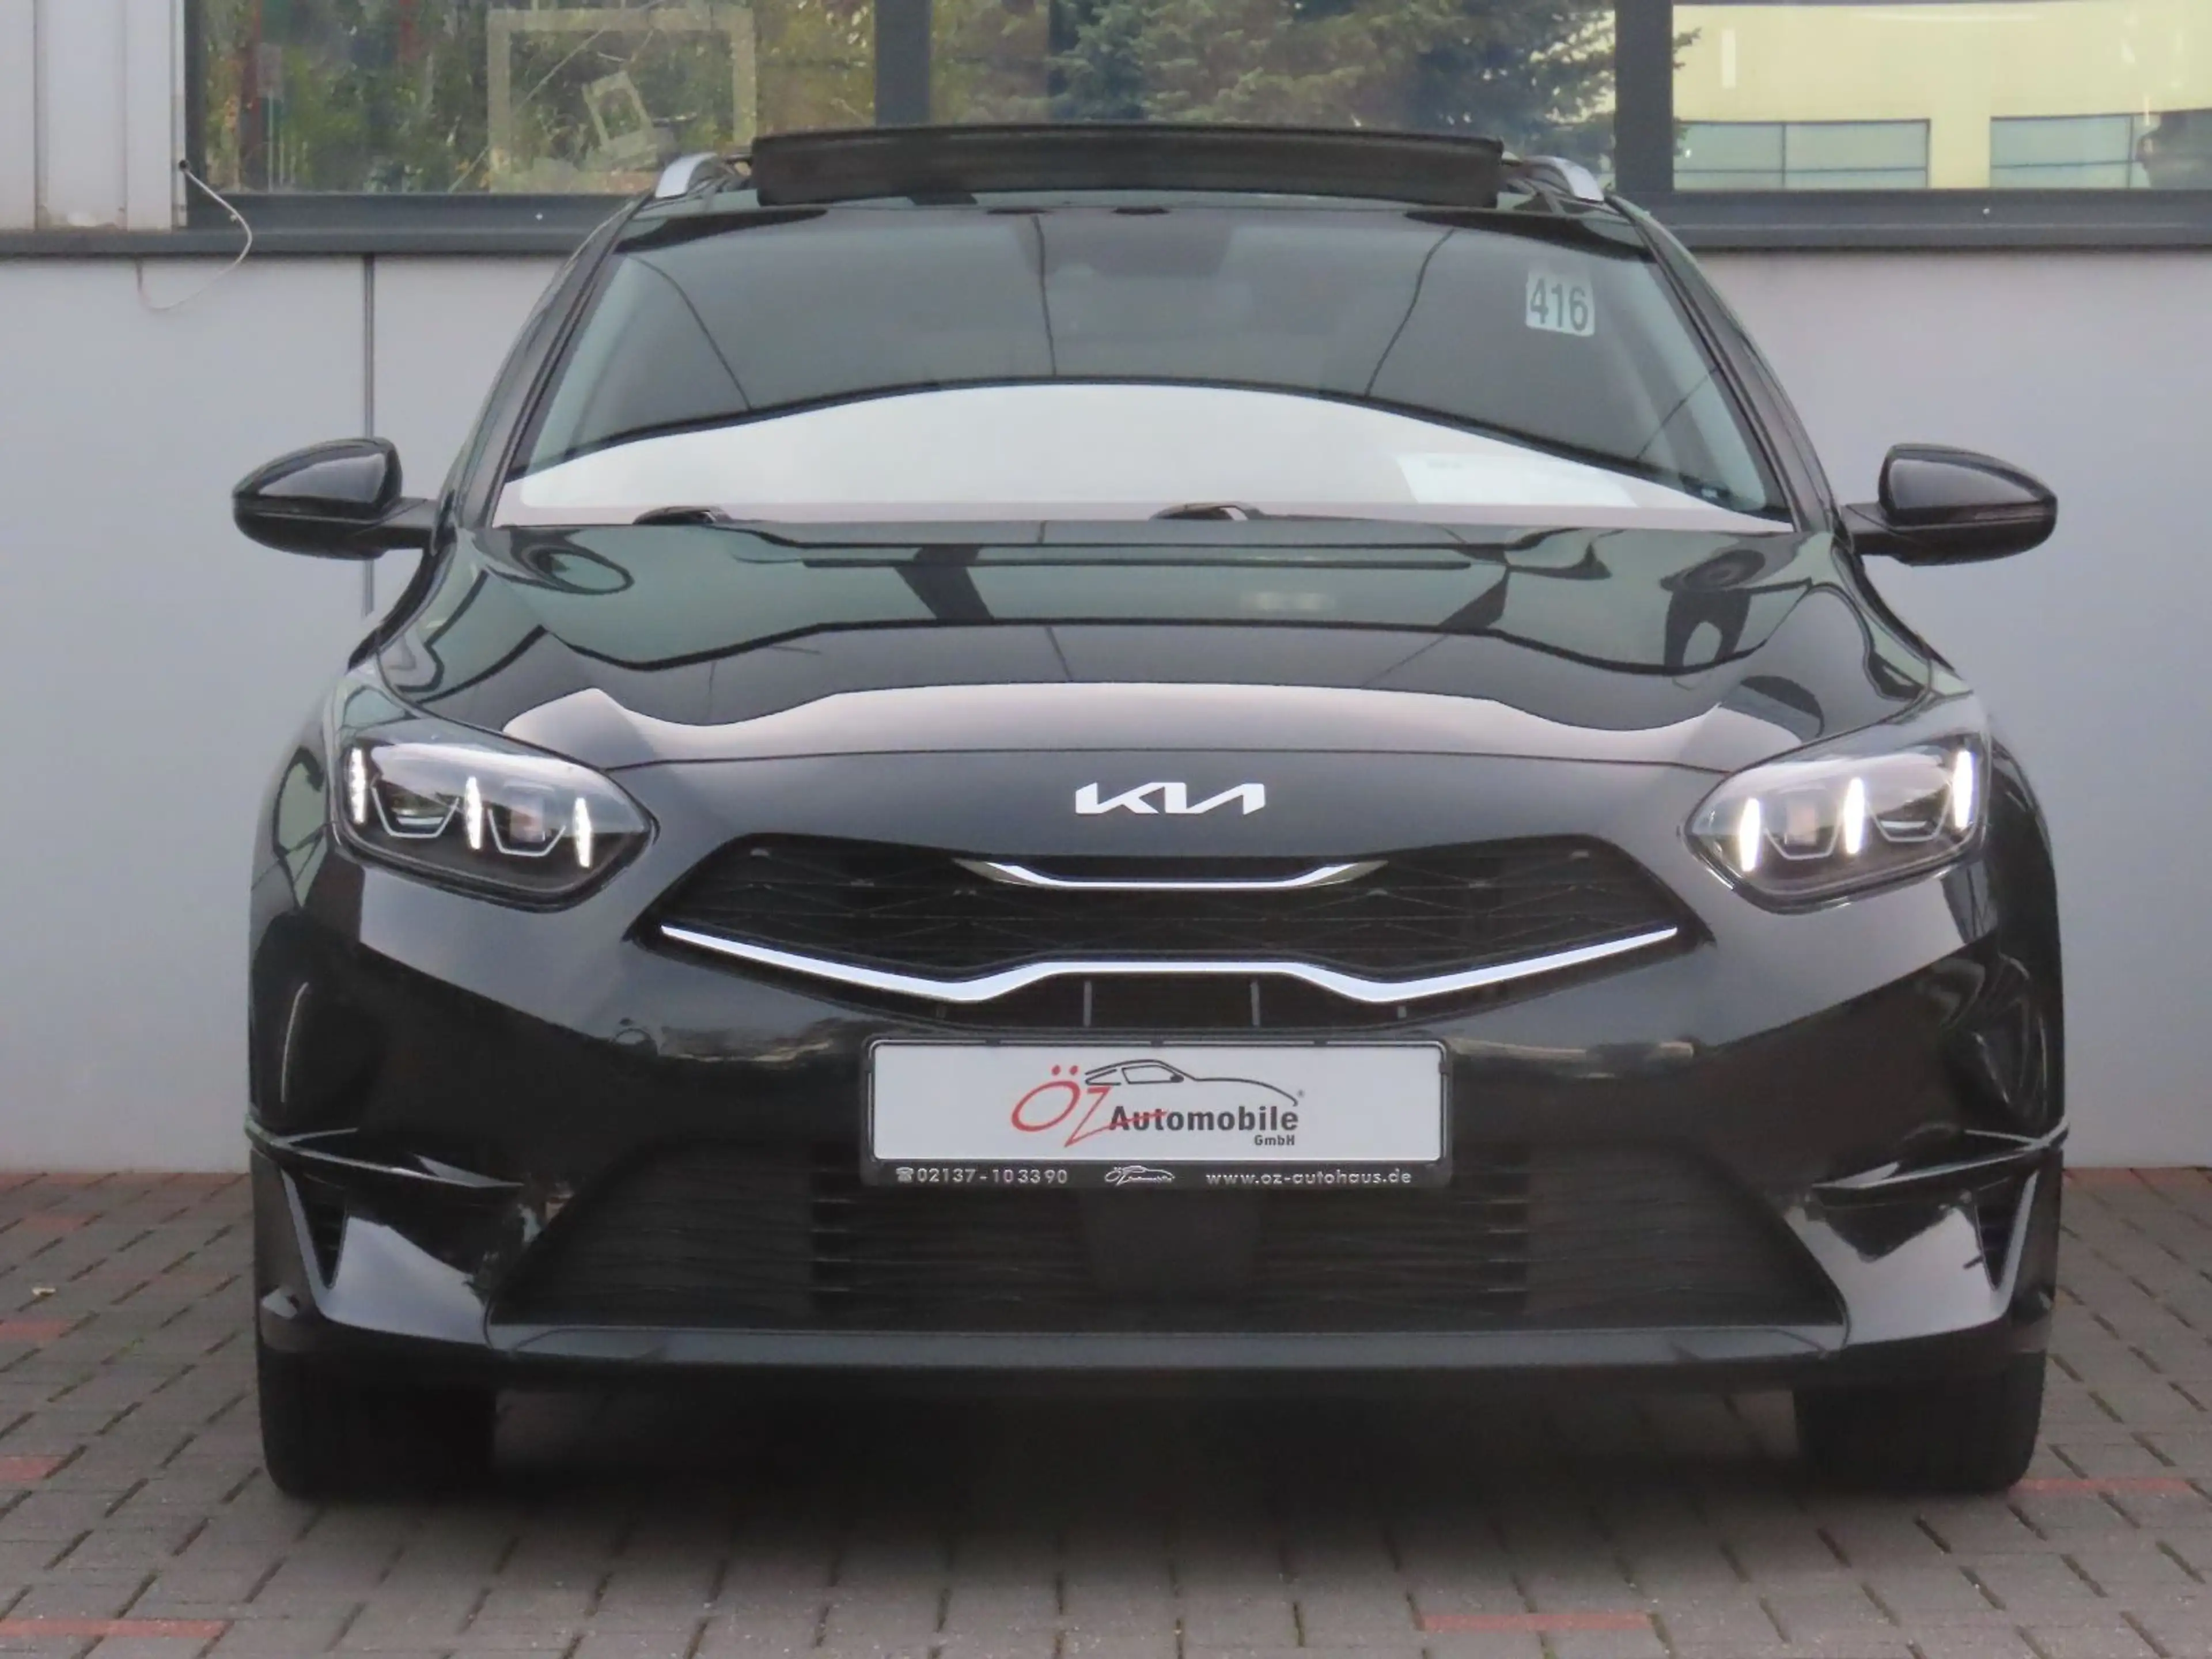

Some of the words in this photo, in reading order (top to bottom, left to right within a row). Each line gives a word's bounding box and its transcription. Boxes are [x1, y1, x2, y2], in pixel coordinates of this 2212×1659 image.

[1529, 277, 1589, 332] 416
[1075, 782, 1265, 815] KIA
[1109, 1105, 1298, 1131] Automobile
[1254, 1135, 1296, 1146] GmbH
[1206, 1168, 1412, 1184] www.oz-autohaus.de
